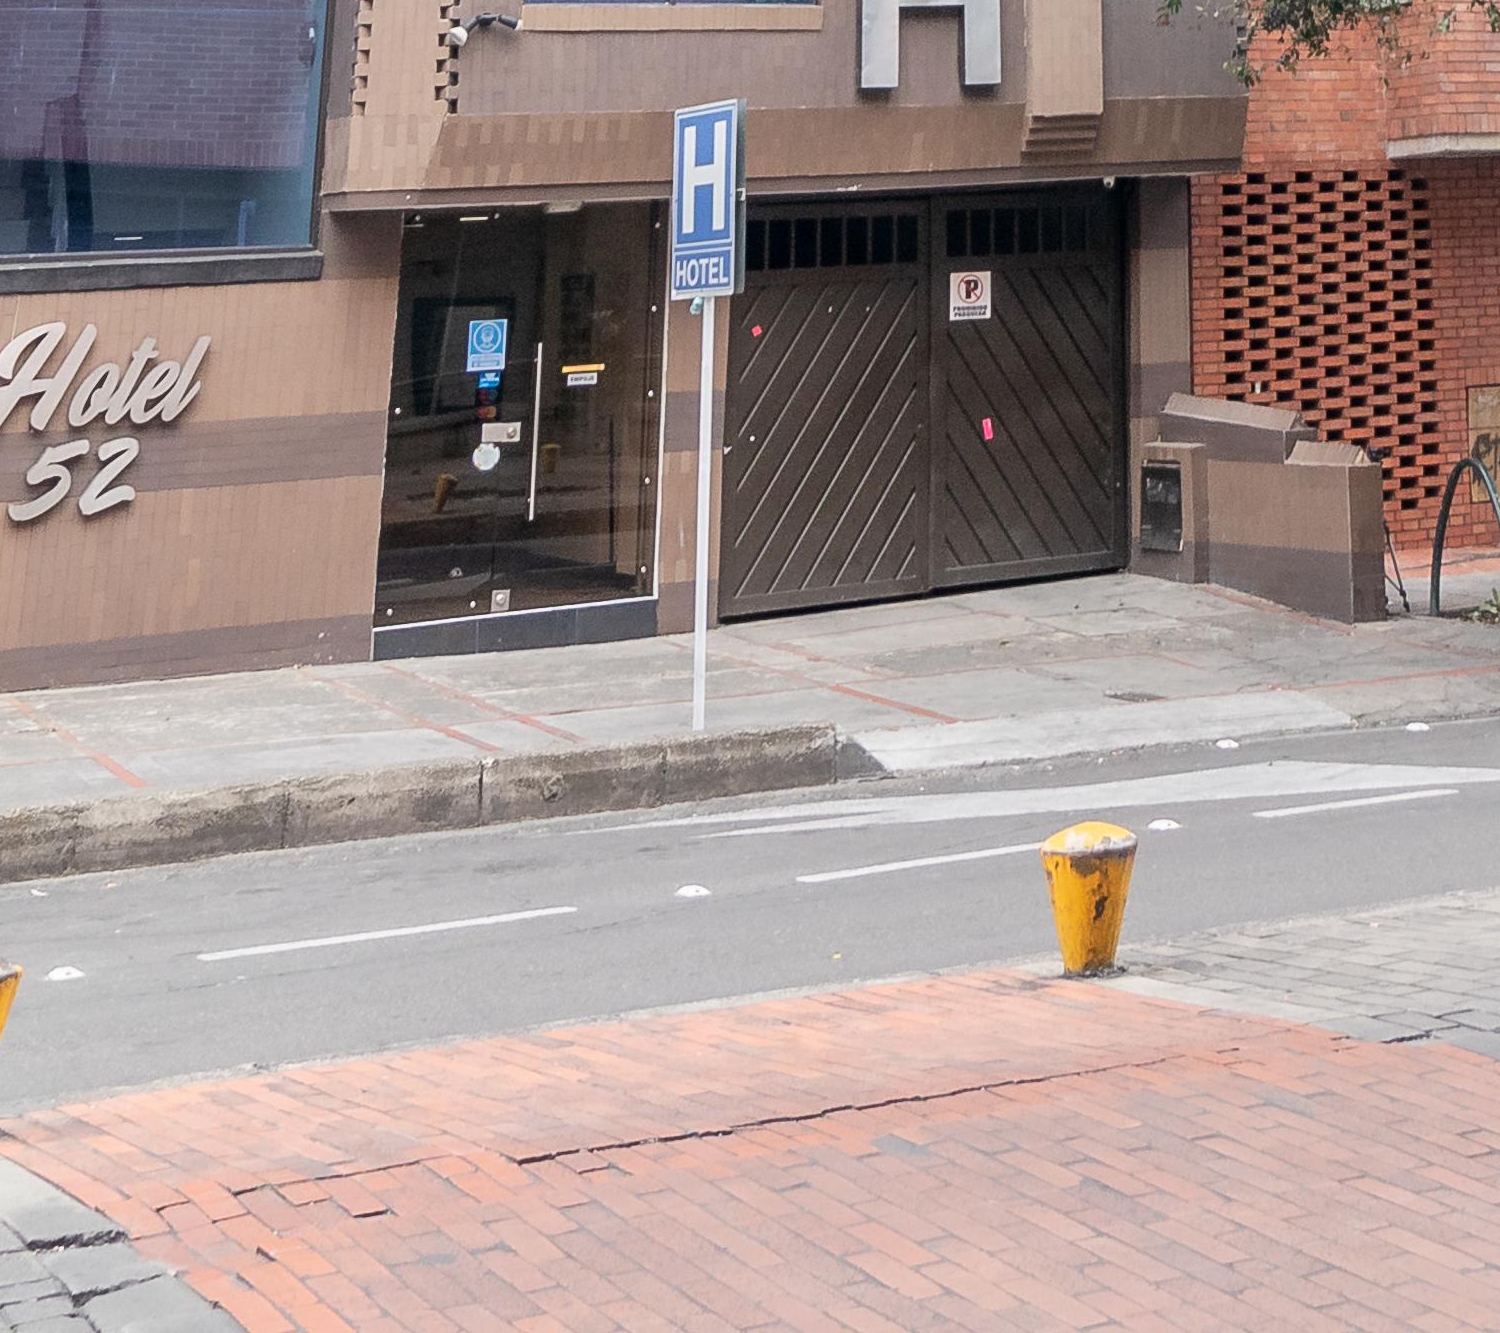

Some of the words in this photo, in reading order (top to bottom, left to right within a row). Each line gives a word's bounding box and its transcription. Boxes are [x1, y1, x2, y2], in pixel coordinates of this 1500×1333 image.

[682, 119, 727, 234] H
[675, 256, 729, 288] HOTEL
[7, 437, 141, 522] 52
